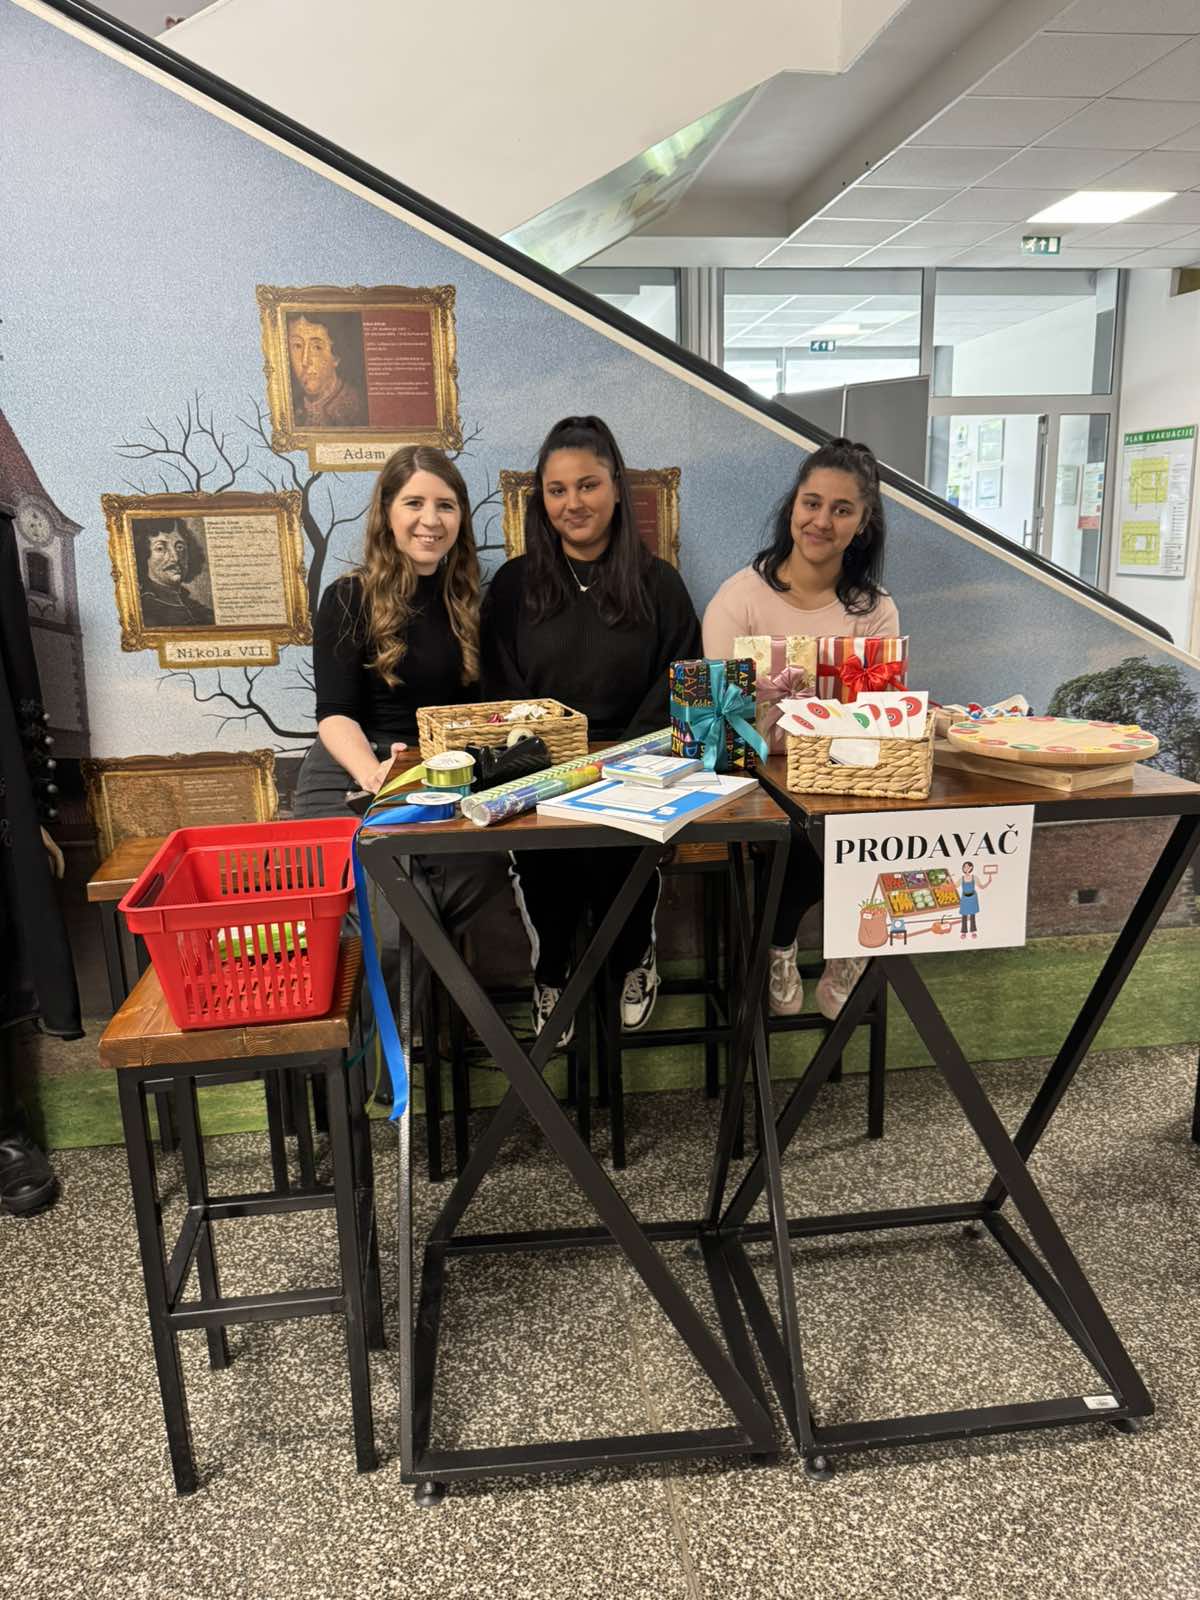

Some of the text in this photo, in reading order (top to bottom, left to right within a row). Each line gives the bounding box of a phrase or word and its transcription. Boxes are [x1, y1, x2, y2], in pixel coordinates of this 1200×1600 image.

[1124, 428, 1194, 443] PLAN EVAKUACIJE
[343, 448, 386, 460] Adam
[177, 644, 269, 659] Nikola VII.
[685, 664, 697, 697] DAY
[834, 823, 1019, 865] PRODAVAČ
